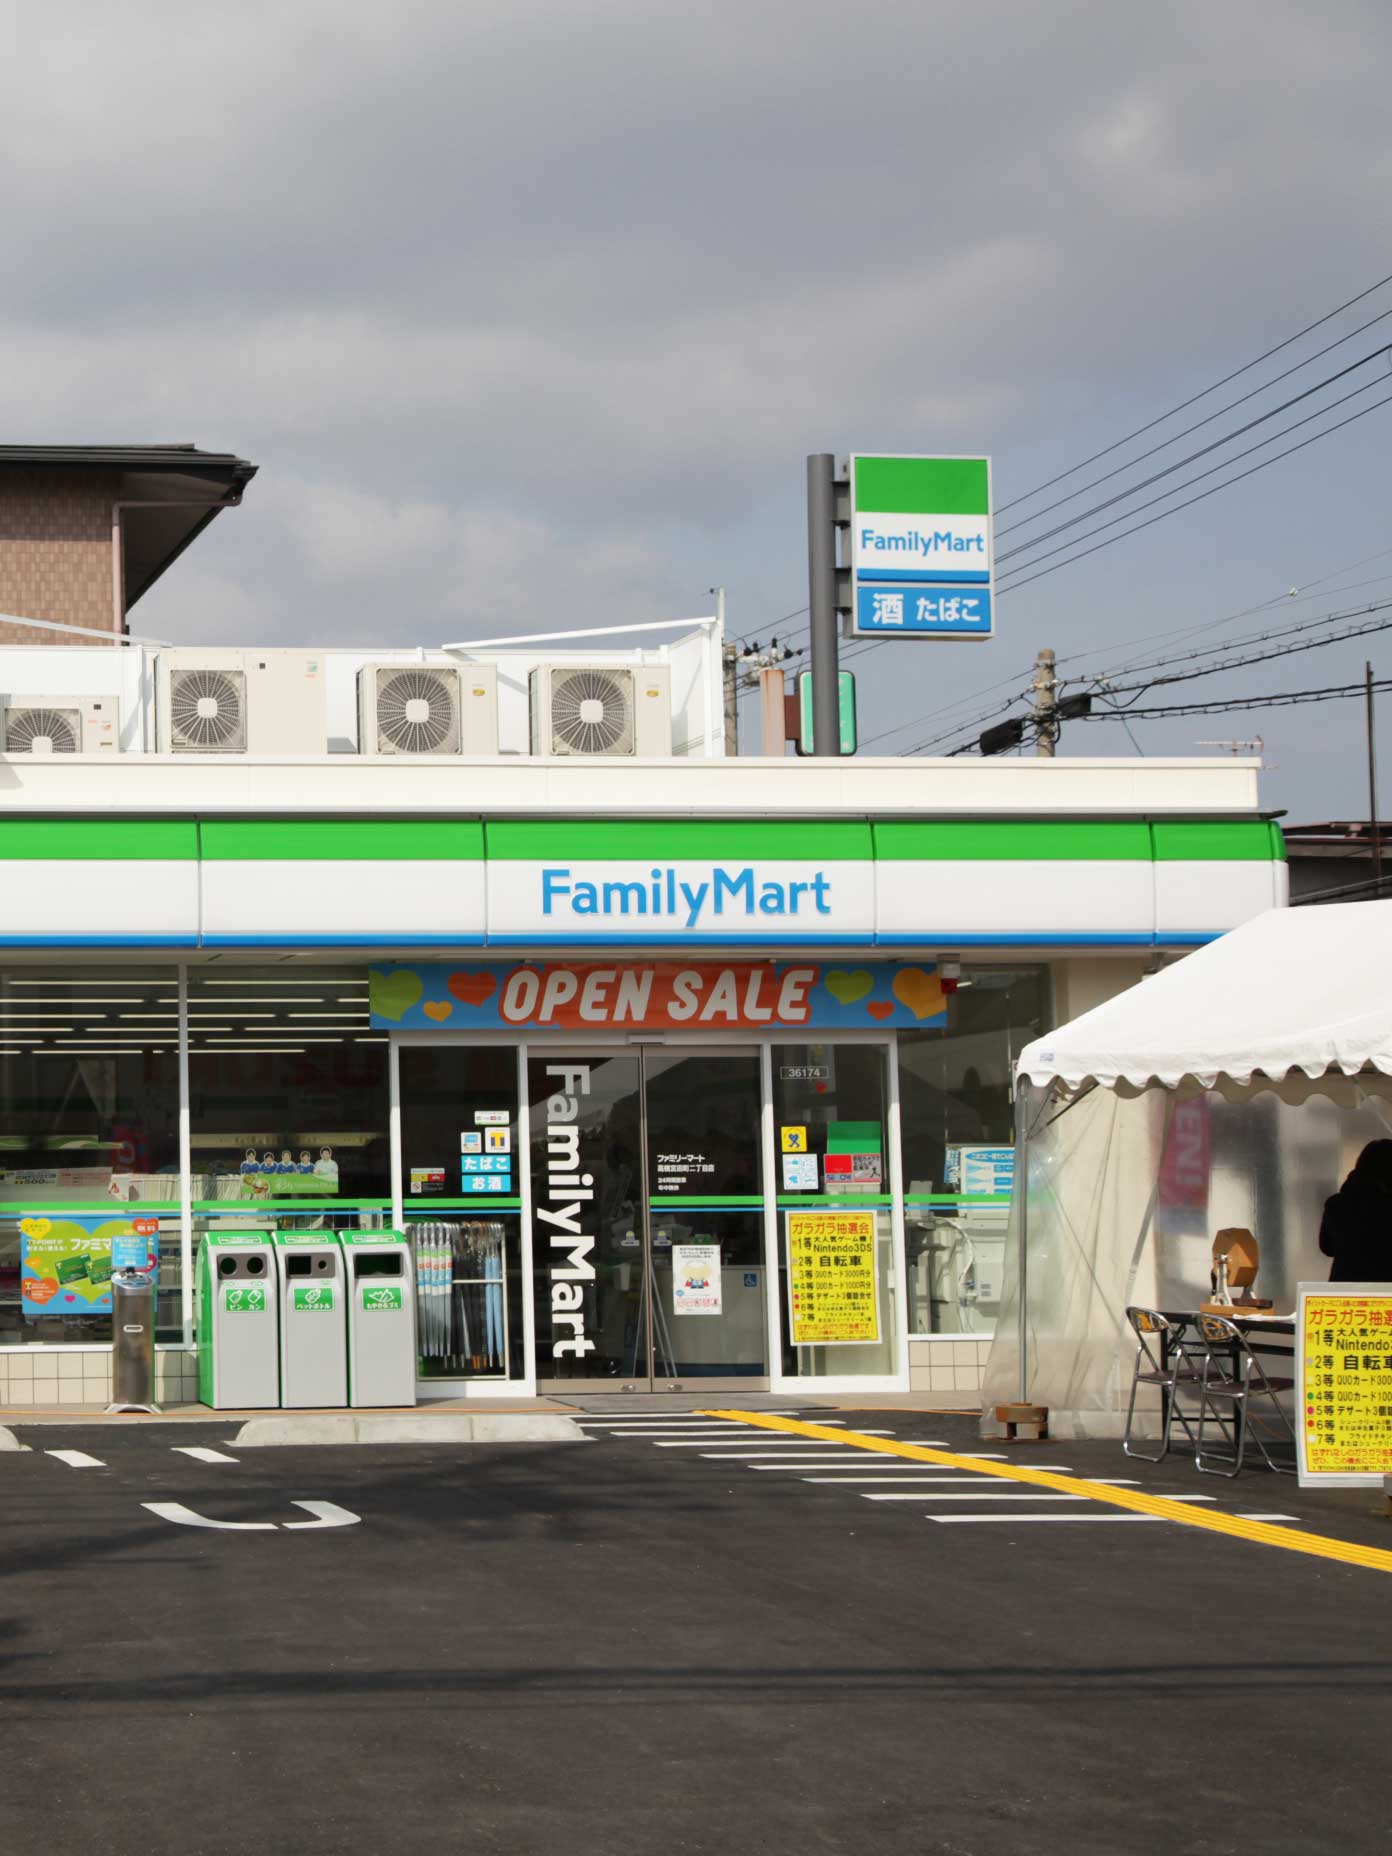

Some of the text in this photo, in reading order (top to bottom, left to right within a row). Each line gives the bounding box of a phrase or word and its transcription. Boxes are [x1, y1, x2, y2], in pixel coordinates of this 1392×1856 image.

[861, 529, 984, 557] FamilyMart
[872, 593, 981, 624] 酒 たばこ
[541, 868, 831, 928] FamilyMart
[503, 969, 814, 1021] OPEN SALE
[788, 1068, 820, 1077] 36174
[464, 1157, 508, 1170] たばこ
[657, 1154, 706, 1163] ファミリーマート
[472, 1176, 502, 1190] お酒
[536, 1065, 596, 1358] FamilyMart
[792, 1222, 870, 1234] ガラガラ抽選会
[70, 1238, 113, 1251] ファミマ
[813, 1244, 873, 1253] Nintendo3DS
[820, 1255, 863, 1267] 自転車
[1315, 1329, 1334, 1347] 1等
[1336, 1339, 1392, 1351] Nintendo
[1315, 1355, 1334, 1370] 2等
[1315, 1374, 1334, 1387] 3等
[1316, 1390, 1334, 1402] 4等
[1316, 1405, 1334, 1416] 5等
[1316, 1420, 1335, 1430] 6等
[1316, 1433, 1335, 1445] 7等
